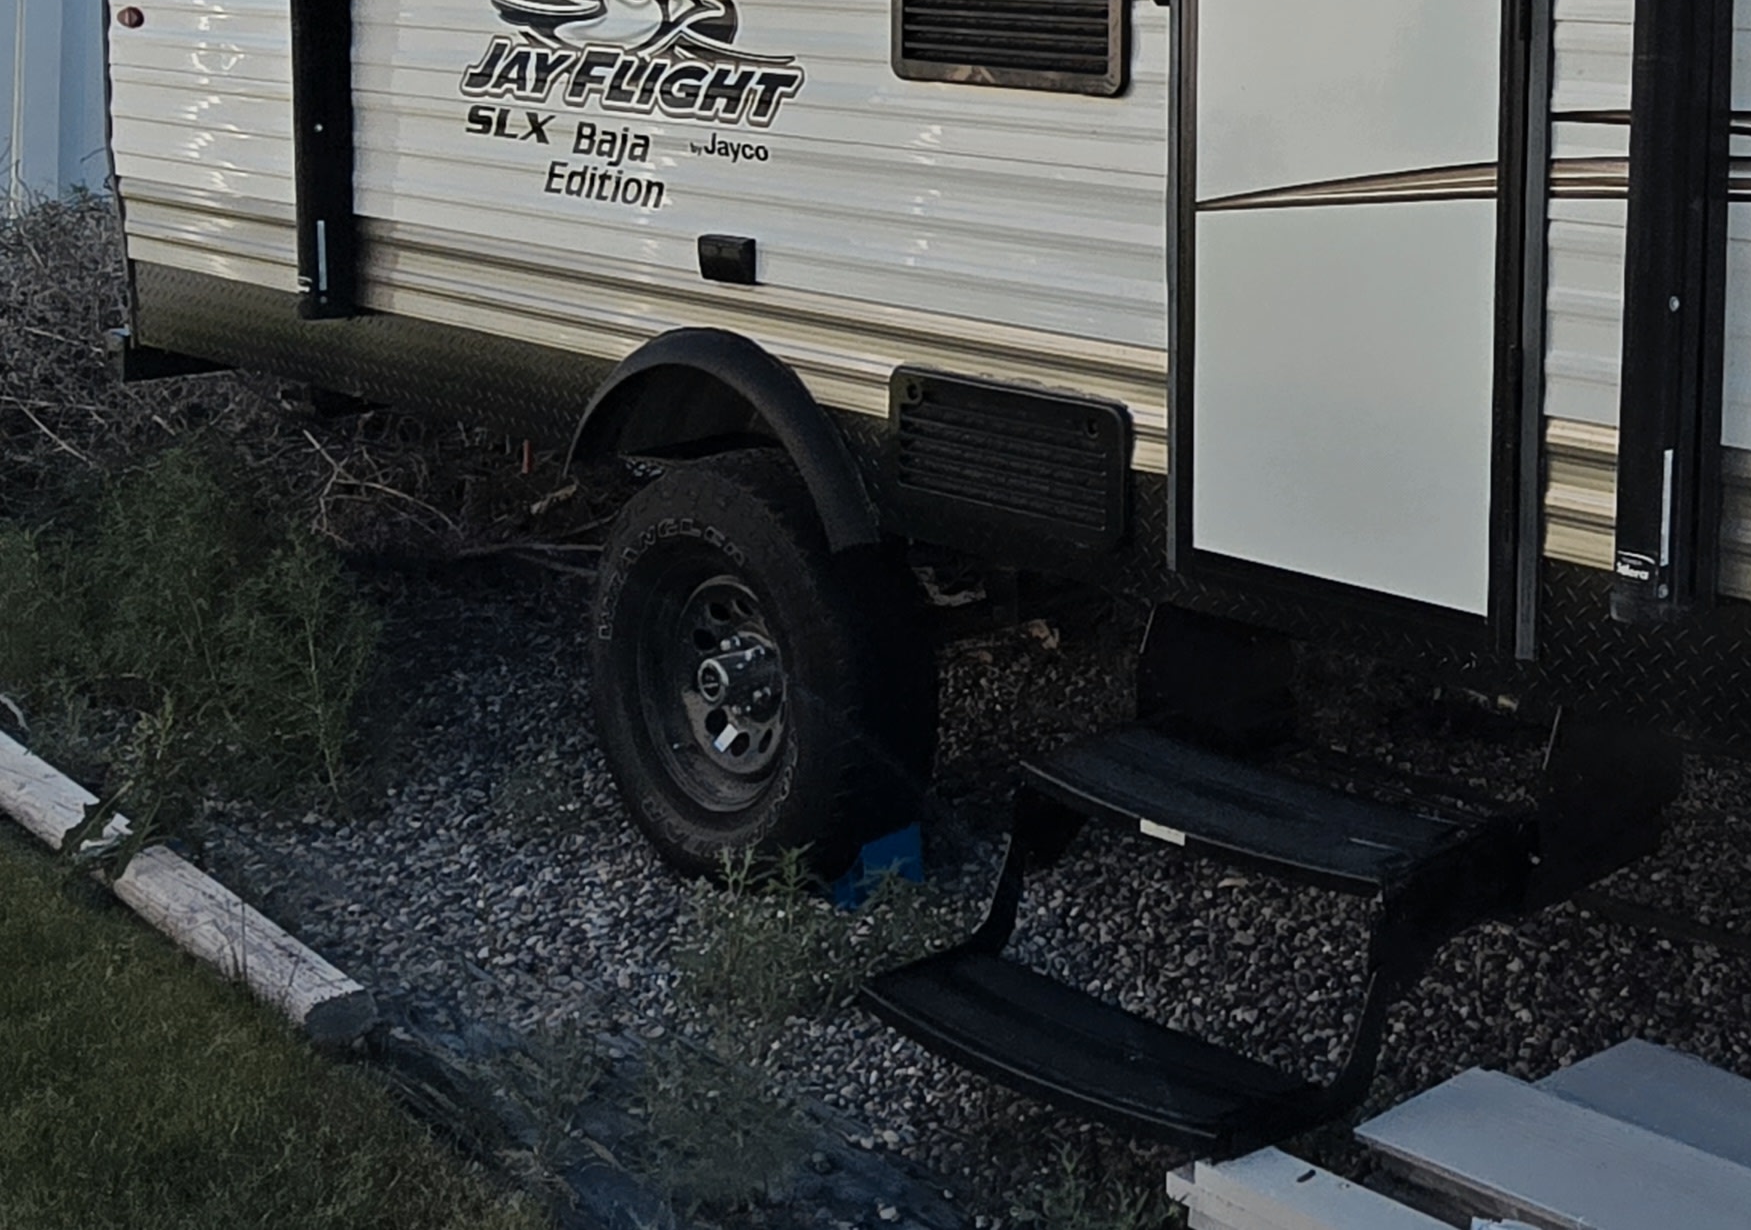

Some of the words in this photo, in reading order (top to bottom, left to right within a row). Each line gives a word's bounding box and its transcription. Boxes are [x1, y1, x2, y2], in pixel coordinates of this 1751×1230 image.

[465, 105, 555, 144] SLX
[572, 122, 650, 166] Baja
[703, 132, 769, 163] Jayco
[544, 161, 665, 209] Edition
